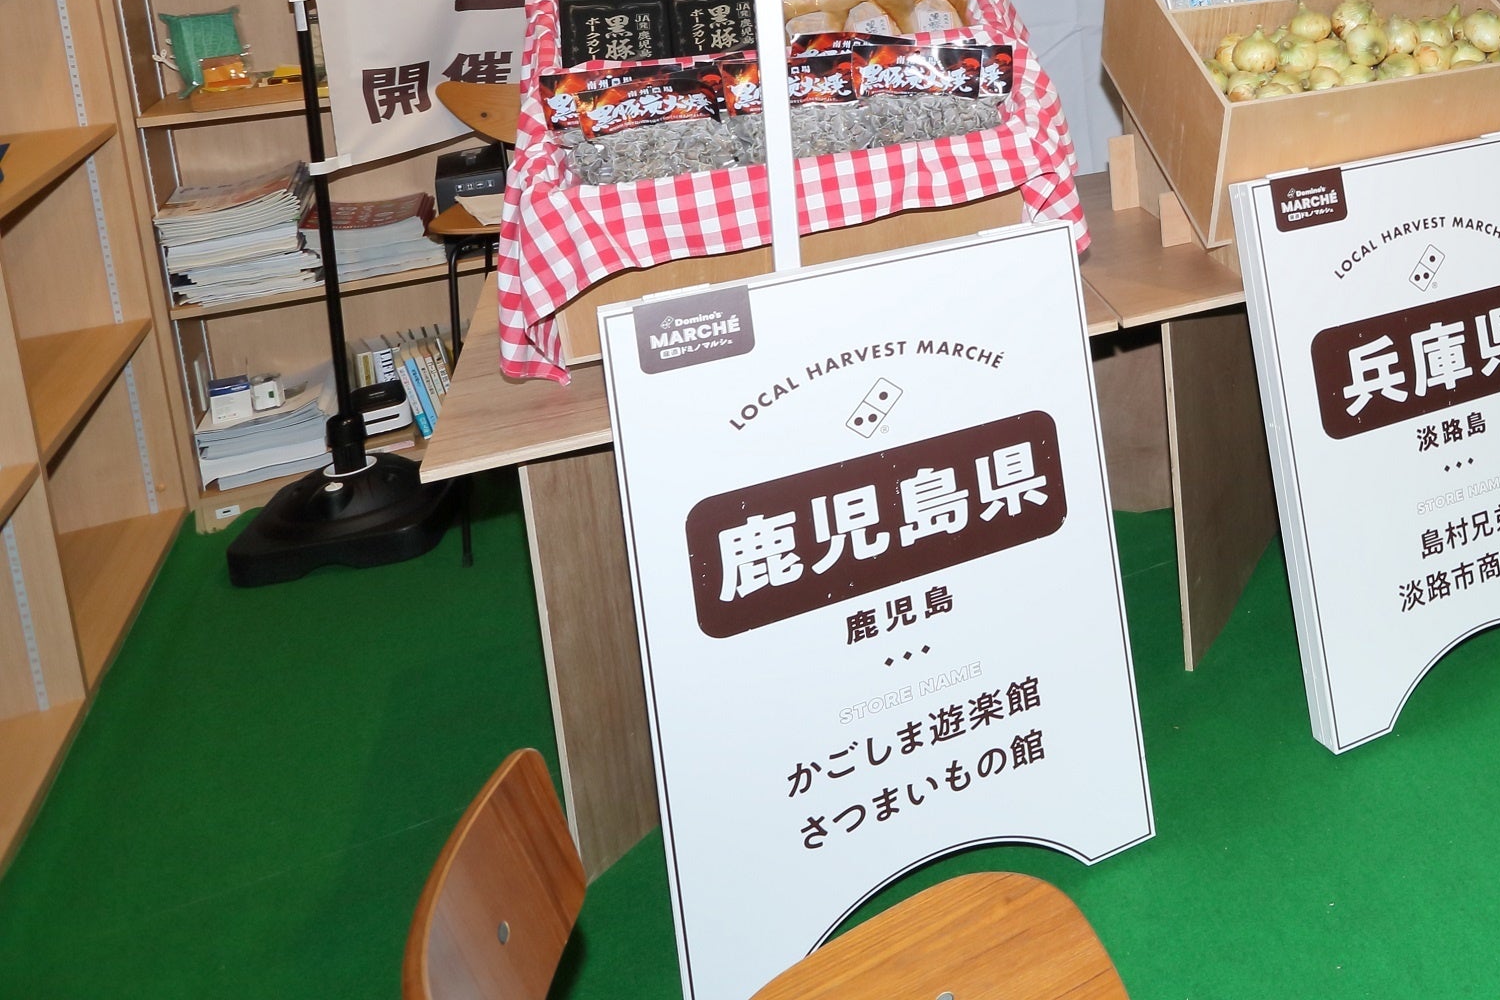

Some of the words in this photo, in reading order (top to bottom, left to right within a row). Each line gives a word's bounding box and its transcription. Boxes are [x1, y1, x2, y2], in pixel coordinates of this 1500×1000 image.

[604, 14, 635, 60] 黒豚
[707, 4, 740, 49] 黒豚
[1280, 188, 1339, 214] MARCHÉ
[1334, 240, 1378, 280] LOCAL
[1381, 216, 1447, 244] HARVEST
[649, 314, 741, 350] MARCHÉ
[674, 310, 722, 327] Domino's
[728, 376, 800, 431] LOCAL
[805, 340, 907, 381] HARVEST
[915, 340, 1005, 370] MARCHÉ
[1416, 411, 1488, 453] 淡路島
[718, 440, 1050, 602] 鹿児島県
[1416, 488, 1465, 516] STORE
[845, 585, 954, 646] 鹿児島
[838, 685, 913, 726] STORE
[918, 660, 983, 698] NAME
[786, 675, 1042, 799] かごしま遊楽館
[799, 728, 1047, 851] さつまいもの館
